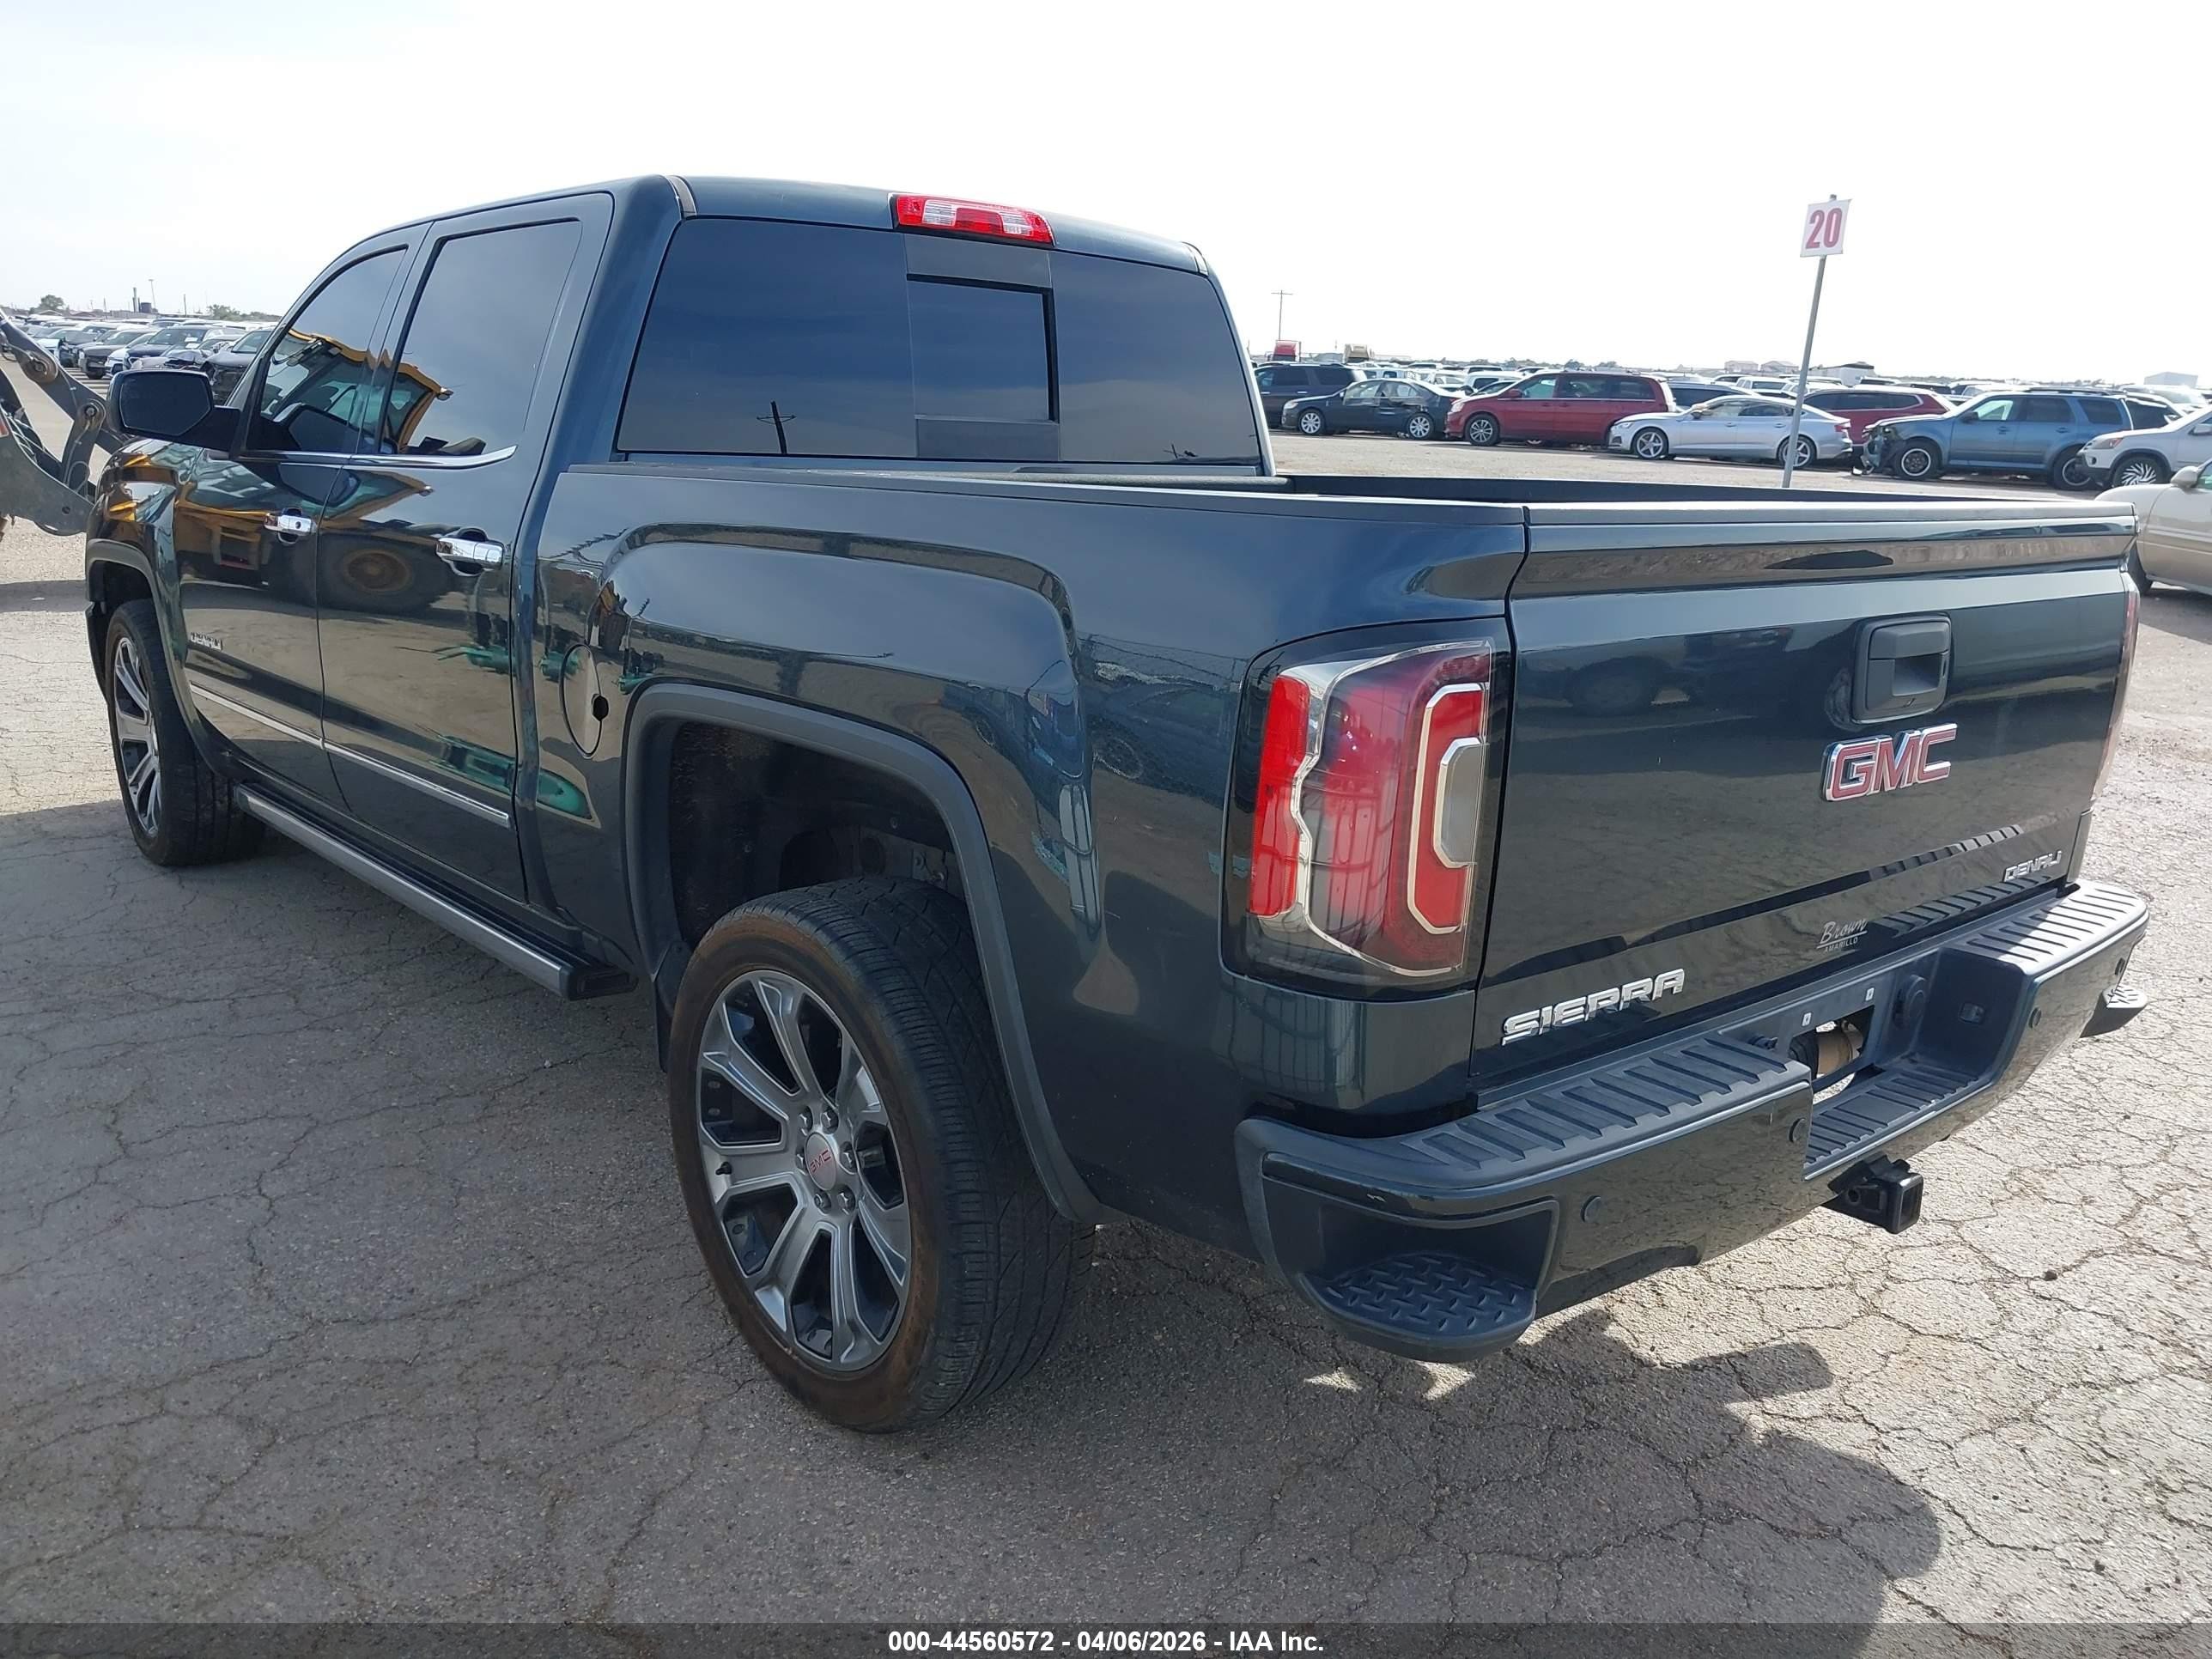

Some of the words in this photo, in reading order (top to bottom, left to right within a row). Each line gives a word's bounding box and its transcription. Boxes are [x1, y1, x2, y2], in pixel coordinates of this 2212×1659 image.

[1805, 207, 1843, 249] 20
[1823, 722, 1958, 801] GMC
[2002, 849, 2063, 882] DENALI
[1820, 918, 1869, 945] Brown
[1501, 968, 1686, 1046] SIERRA
[810, 1149, 831, 1173] GMC
